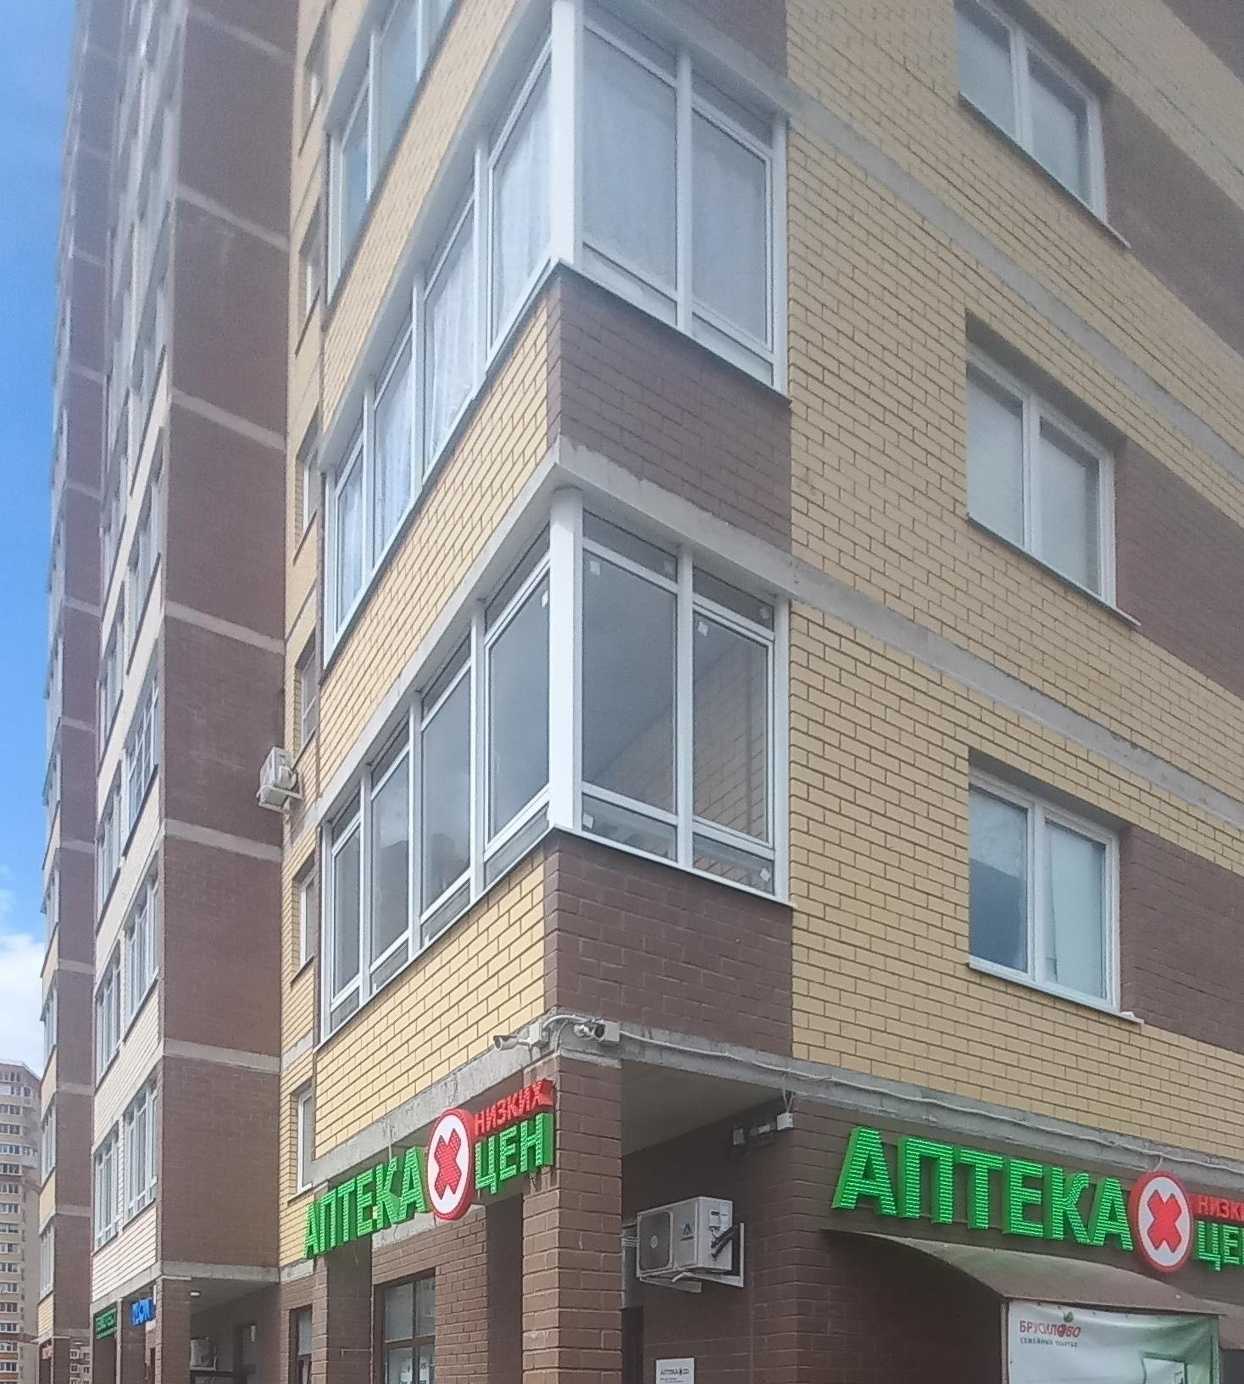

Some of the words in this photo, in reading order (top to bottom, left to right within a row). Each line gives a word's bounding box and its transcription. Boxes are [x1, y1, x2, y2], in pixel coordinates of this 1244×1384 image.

[474, 1079, 555, 1137] НИЗКИХ
[475, 1113, 554, 1195] ЦЕН
[832, 1125, 1134, 1252] АПТЕКА
[303, 1145, 432, 1259] АПТЕКА
[1197, 1193, 1244, 1222] НИЗК
